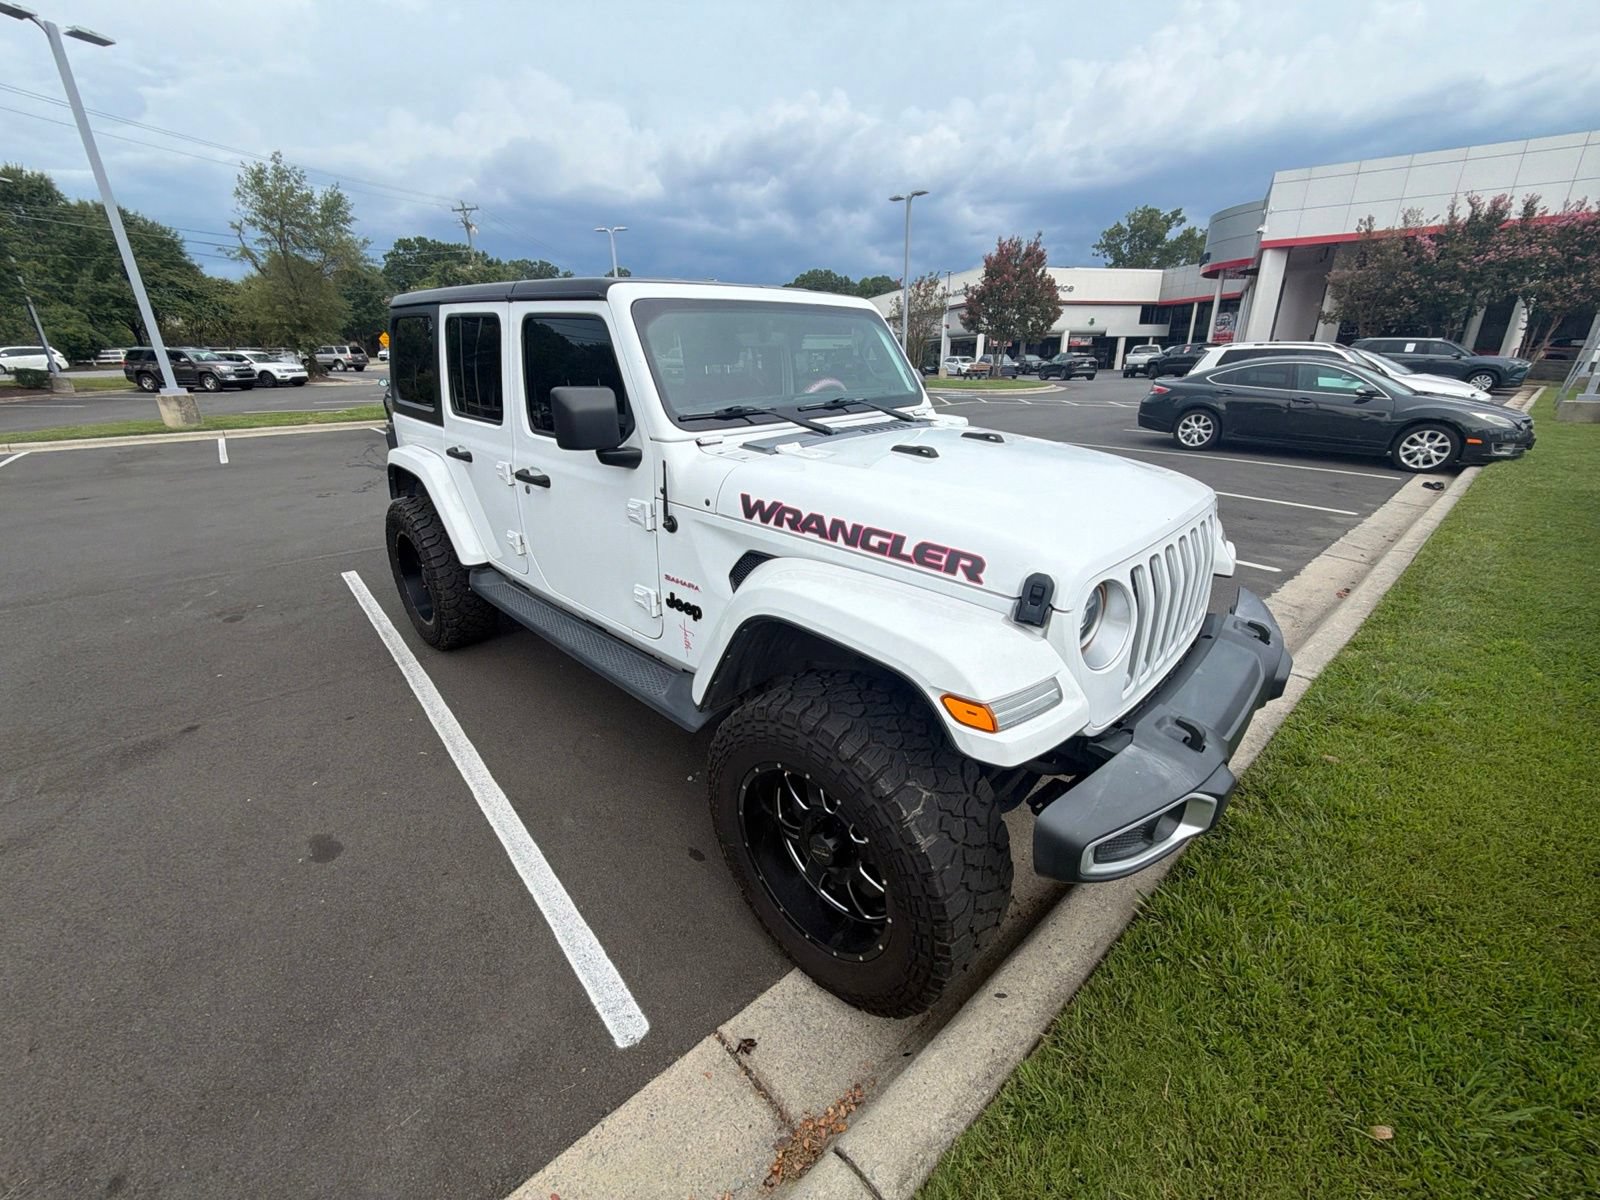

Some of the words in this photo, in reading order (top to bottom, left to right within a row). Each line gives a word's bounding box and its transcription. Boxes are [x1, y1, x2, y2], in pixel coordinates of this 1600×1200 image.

[741, 493, 986, 585] WRANGLER
[664, 573, 702, 592] SAHARA
[666, 592, 702, 622] Jeep
